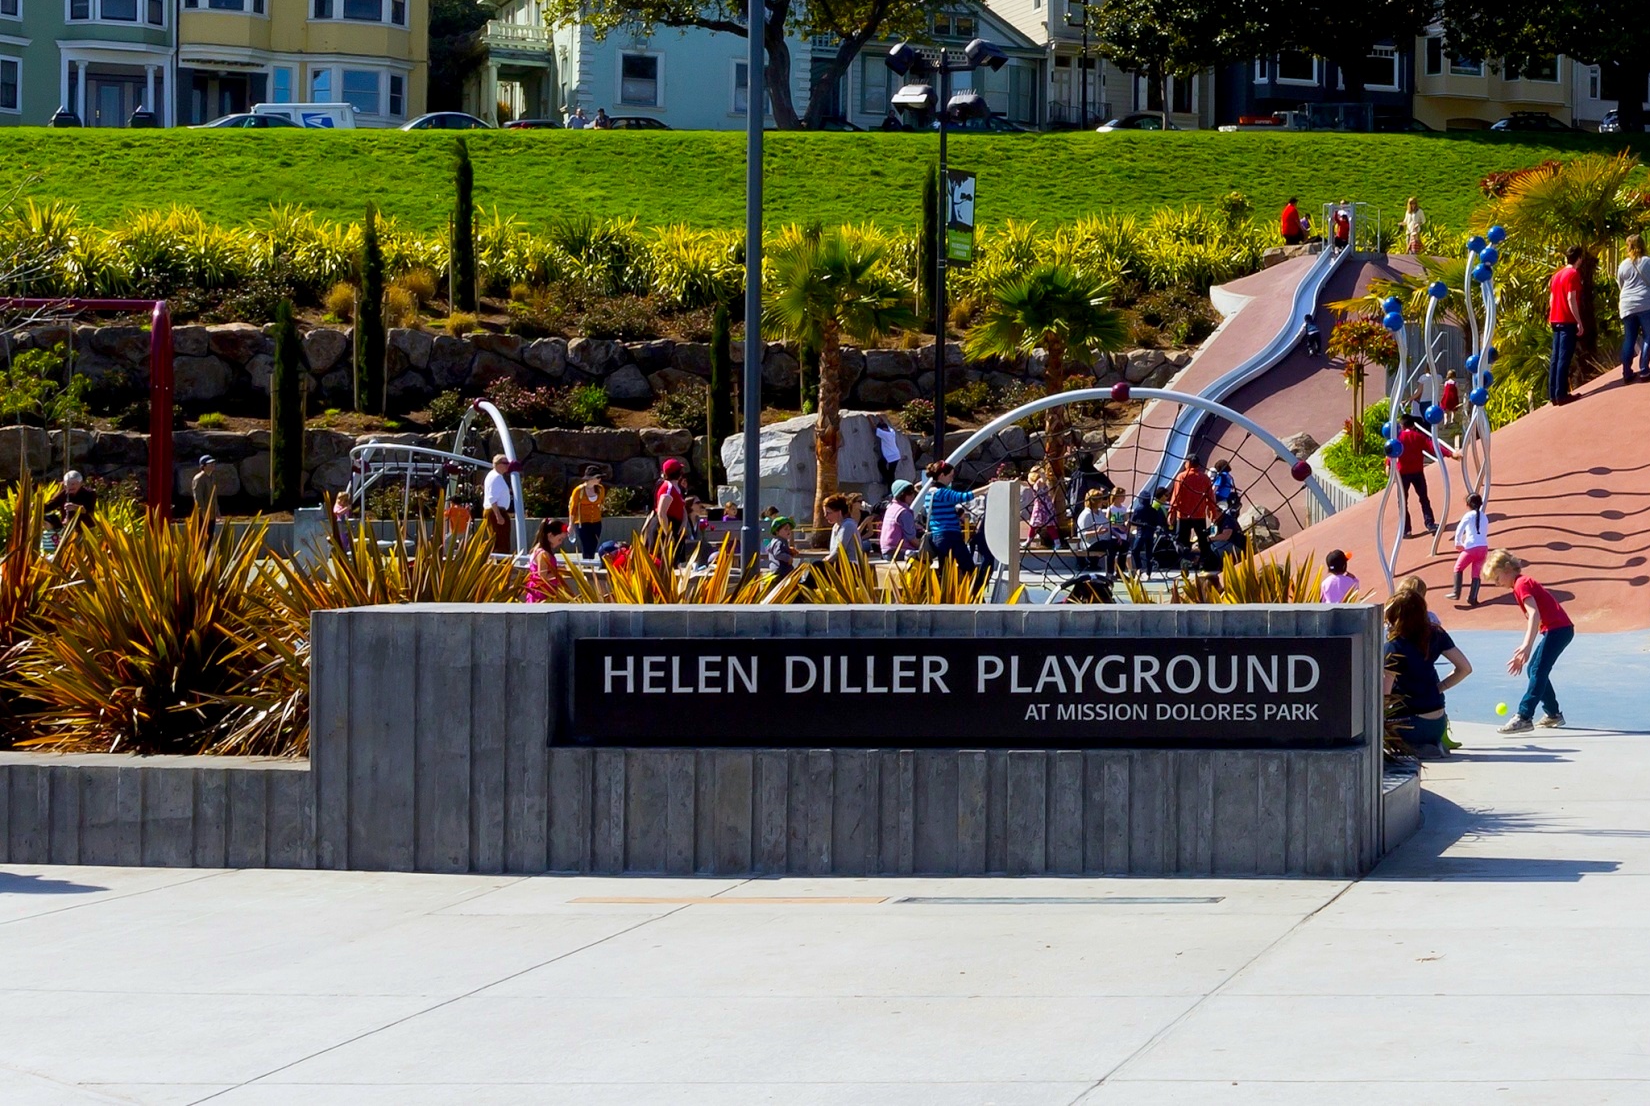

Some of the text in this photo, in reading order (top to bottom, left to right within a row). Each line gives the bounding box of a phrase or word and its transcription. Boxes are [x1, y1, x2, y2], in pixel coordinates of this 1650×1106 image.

[604, 654, 1320, 694] HELEN DILLER PLAYGROUND
[1024, 703, 1319, 721] AT MISSION DOLORES PARK
